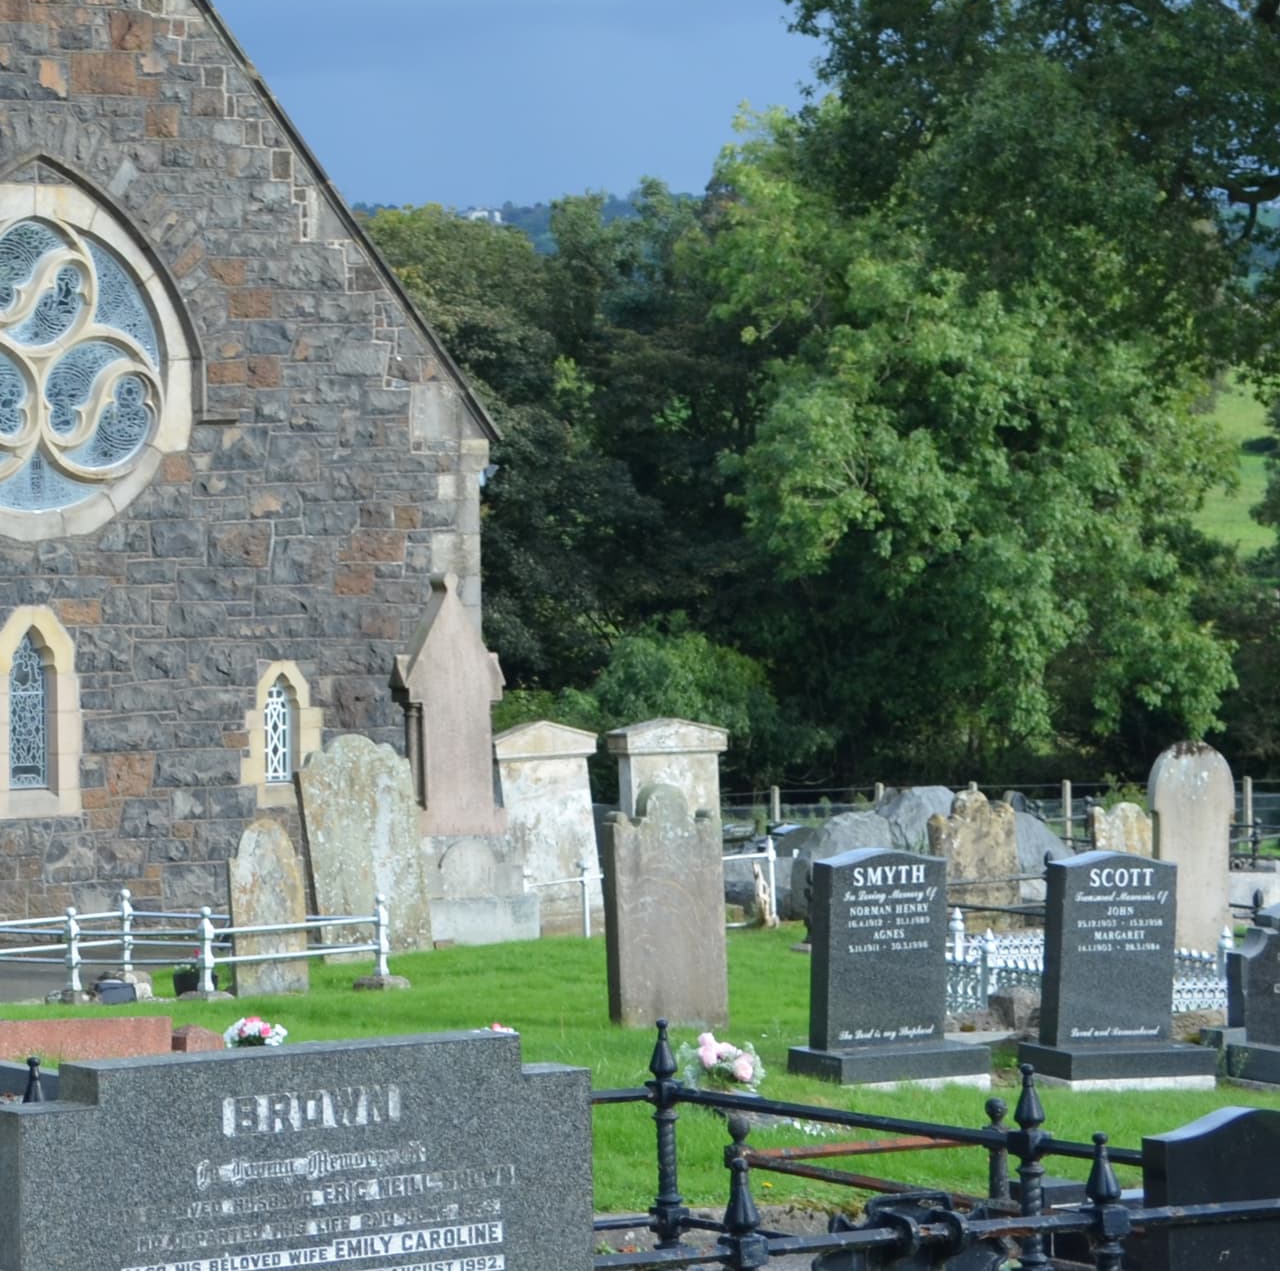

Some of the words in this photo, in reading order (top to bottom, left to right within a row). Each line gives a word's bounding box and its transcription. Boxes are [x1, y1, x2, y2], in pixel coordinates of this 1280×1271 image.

[853, 864, 925, 886] SMYTH
[1090, 868, 1154, 887] SCOTT
[850, 906, 892, 917] NORMAN
[896, 903, 928, 914] HENRY
[1107, 906, 1134, 916] JOHN
[873, 929, 904, 940] AGNES
[1094, 930, 1145, 940] MARGARET
[231, 1087, 392, 1135] BROWN
[209, 1254, 281, 1271] BELOVED
[289, 1248, 328, 1263] WIFE
[335, 1235, 392, 1259] EMILY
[402, 1224, 499, 1251] CAROLINE
[461, 1257, 502, 1271] 1992.
